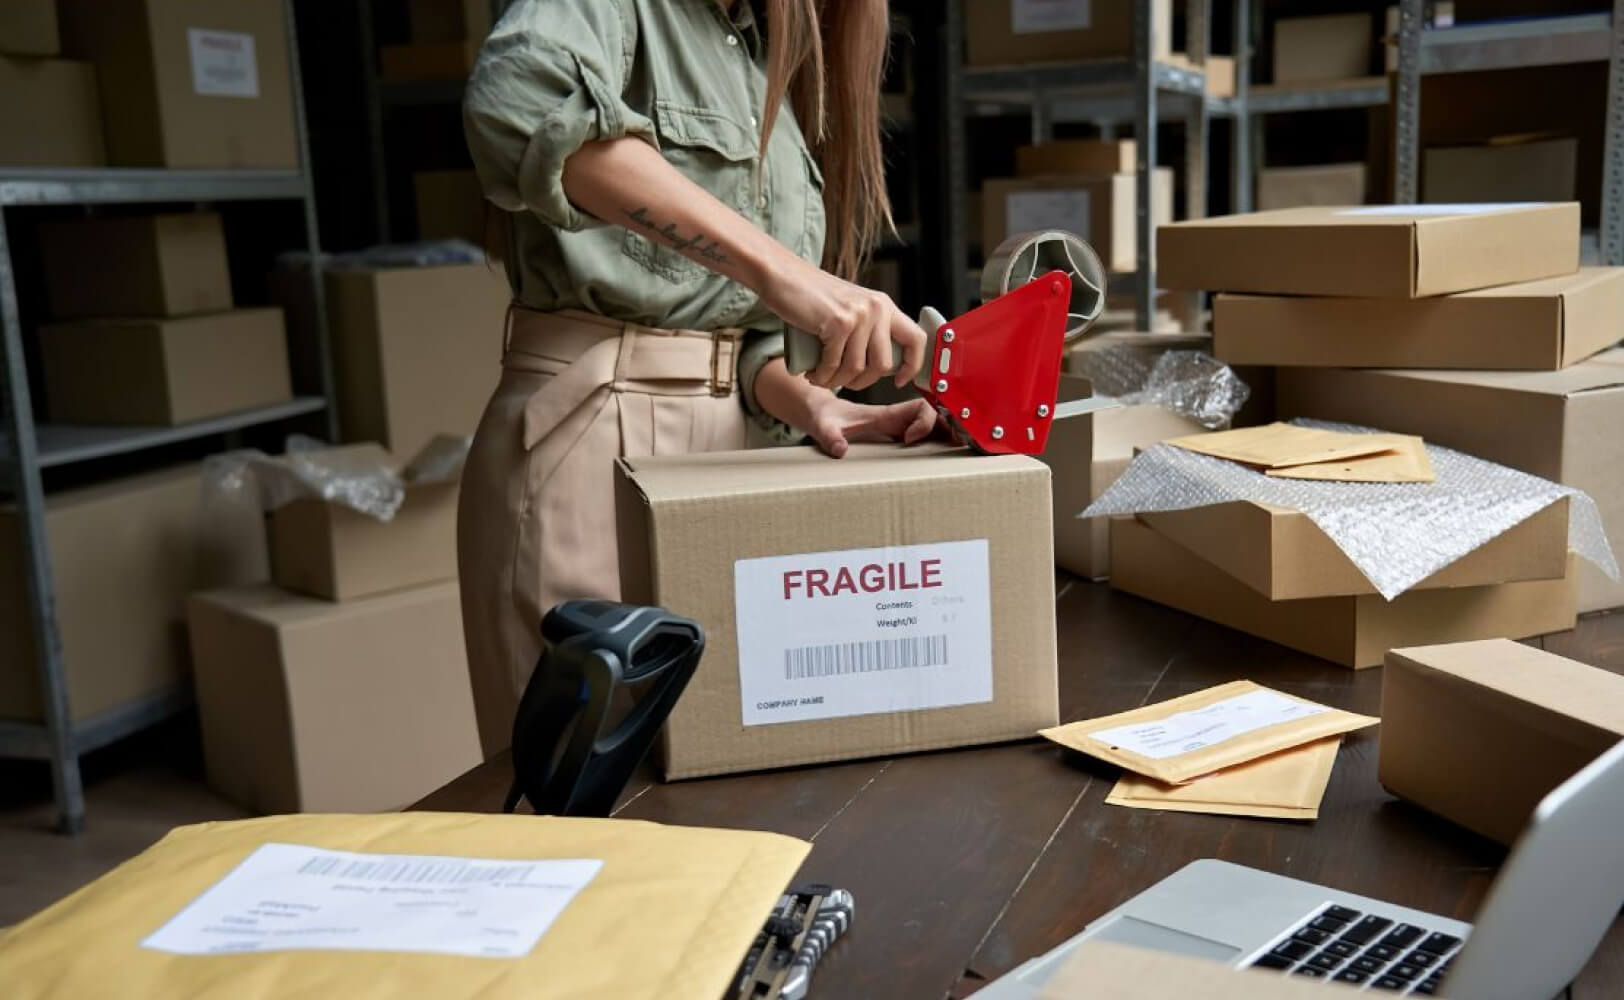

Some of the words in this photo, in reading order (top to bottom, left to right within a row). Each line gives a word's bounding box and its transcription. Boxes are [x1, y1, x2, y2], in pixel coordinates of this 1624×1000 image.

[783, 559, 943, 600] FRAGILE
[876, 601, 913, 610] Contents
[756, 699, 798, 711] COMPANY
[800, 696, 824, 705] NAME
